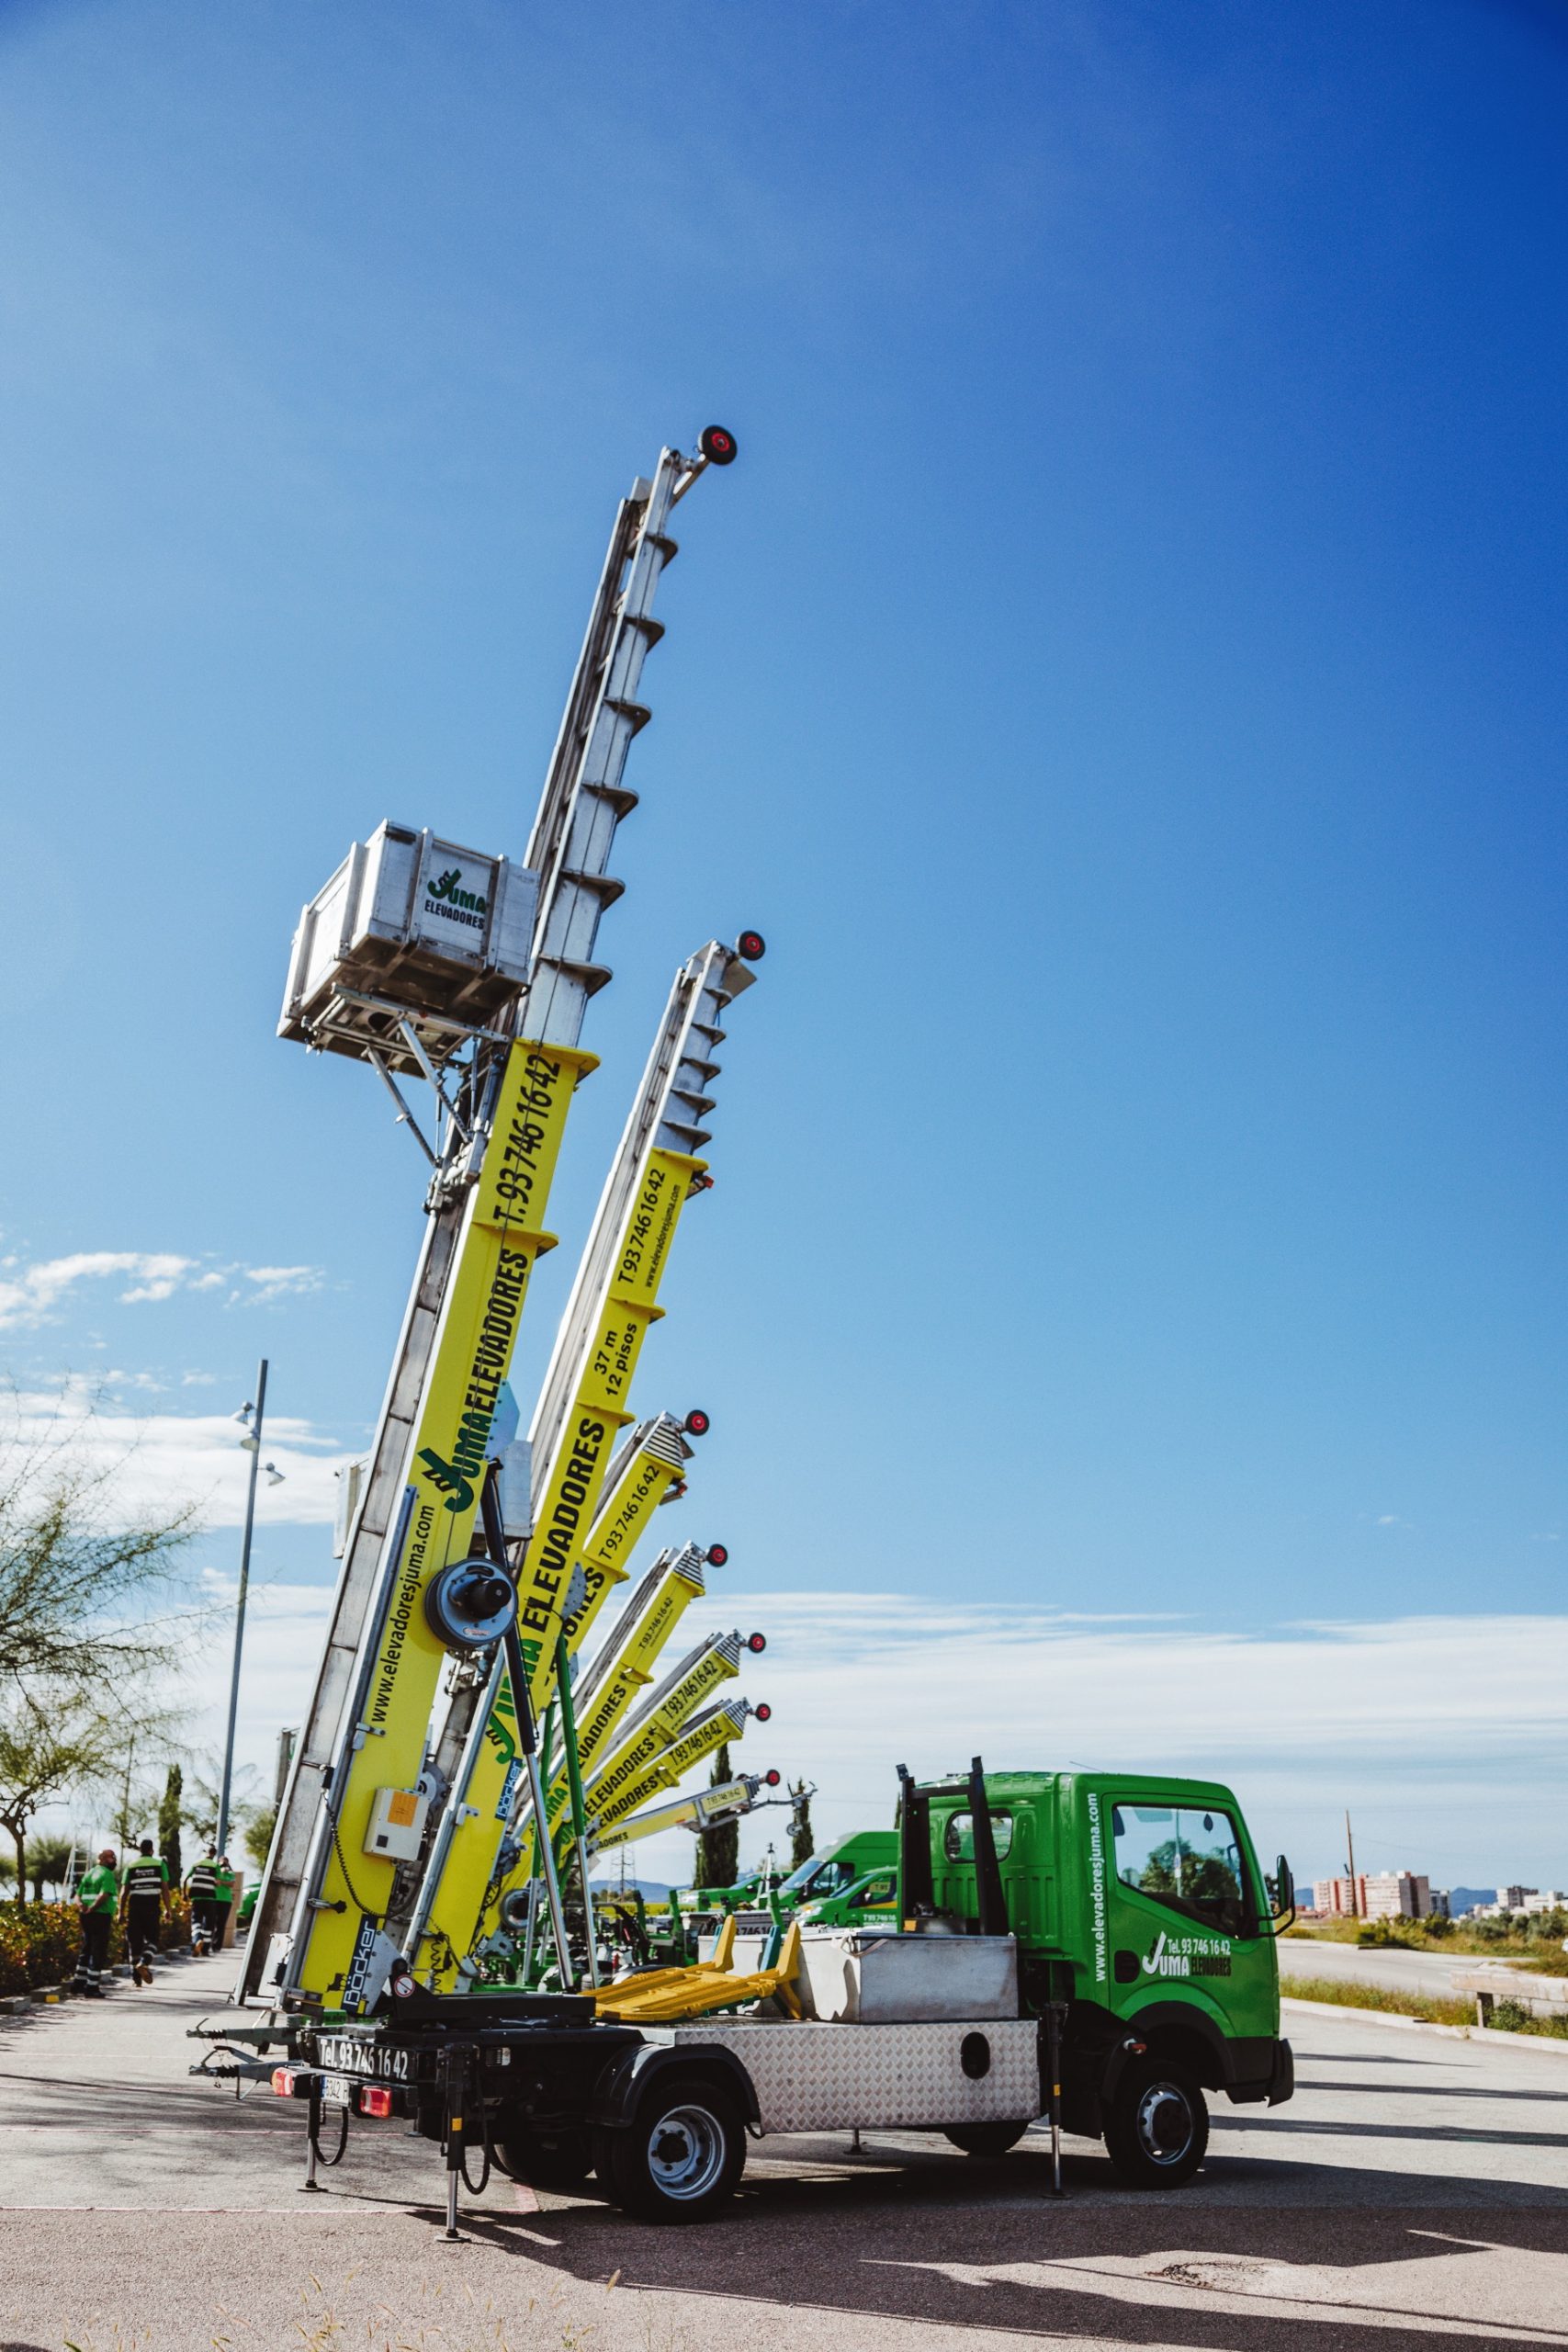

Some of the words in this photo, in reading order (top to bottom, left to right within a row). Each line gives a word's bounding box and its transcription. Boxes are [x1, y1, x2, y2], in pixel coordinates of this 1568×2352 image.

[424, 899, 485, 930] ELEVADORES
[646, 1184, 681, 1287] www.elevadoresjuma.com
[594, 1351, 610, 1374] 37
[605, 1330, 617, 1348] m
[605, 1374, 622, 1396] 12
[615, 1323, 637, 1373] pisos
[521, 1418, 604, 1633] ELEVADORES
[371, 1505, 434, 1722] www.elevadoresjuma.com
[584, 1737, 655, 1816] ELEVADORES
[1088, 1792, 1106, 1983] www.elevadoresjuma.com
[1142, 1930, 1190, 1976] JUMA
[1190, 1956, 1232, 1976] ELEVADORES
[1167, 1939, 1180, 1954] Tel.
[1181, 1938, 1192, 1954] 93
[1193, 1939, 1209, 1955] 746
[1210, 1939, 1220, 1955] 16
[1221, 1939, 1231, 1956] 42
[320, 2038, 338, 2068] Tel.
[339, 2041, 353, 2071] 93
[355, 2044, 375, 2075] 746
[378, 2048, 391, 2076] 16
[393, 2050, 409, 2080] 42
